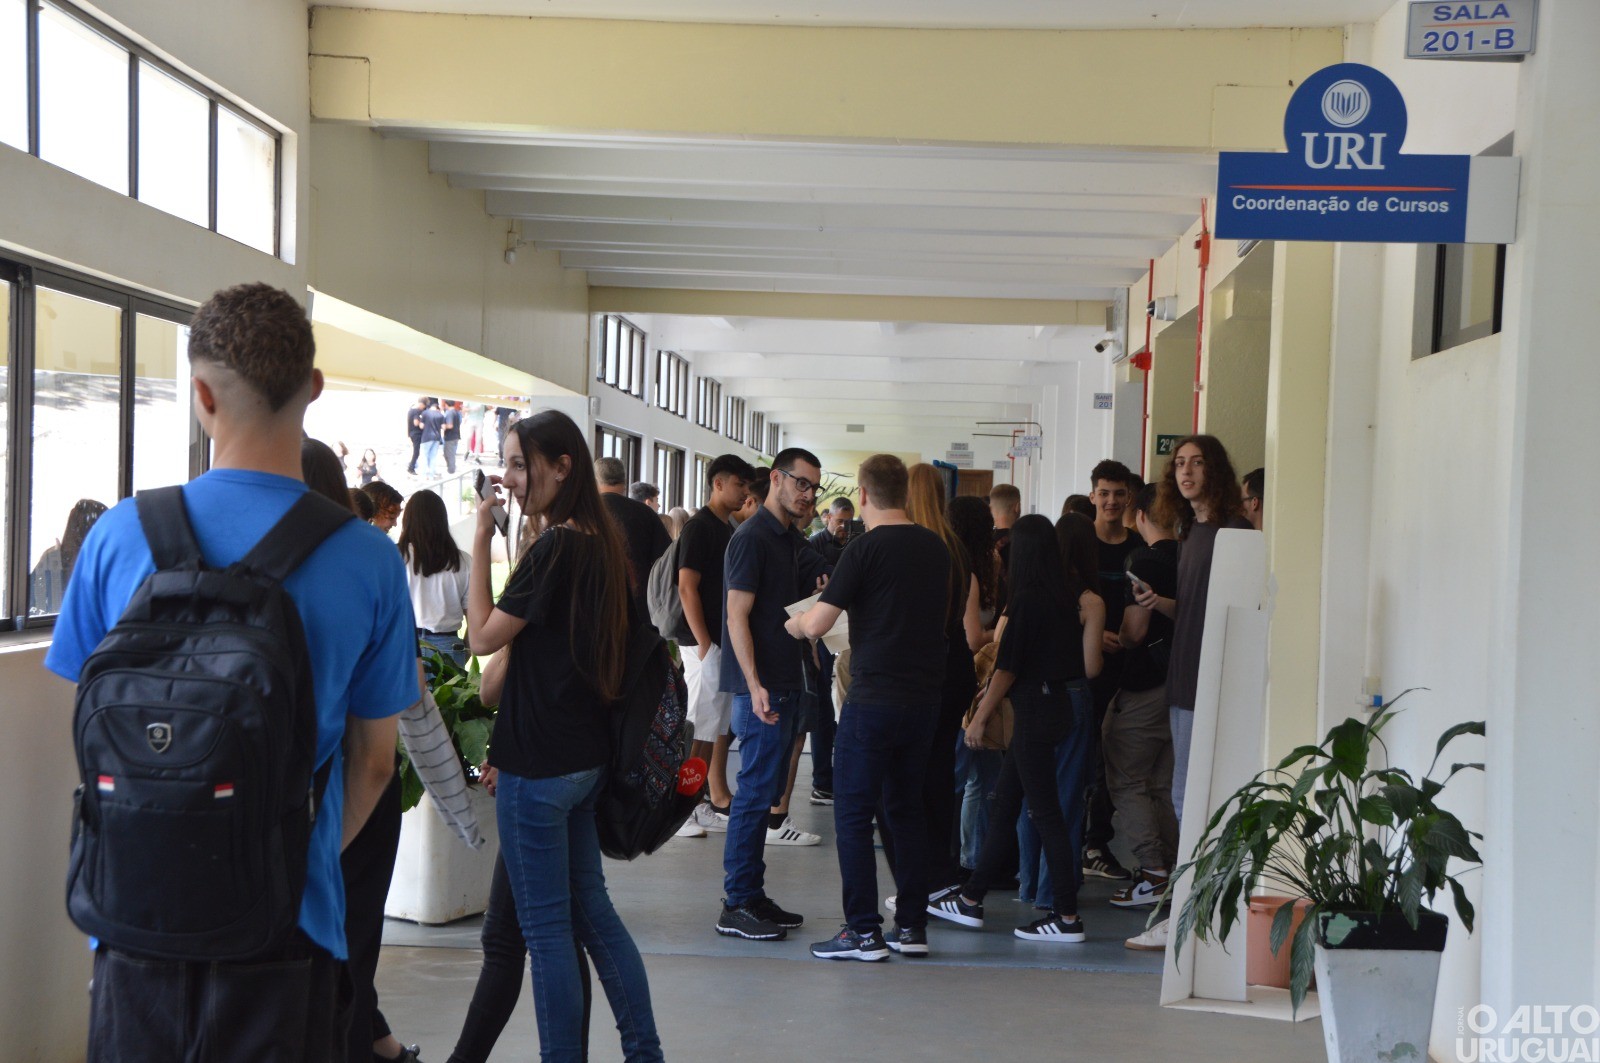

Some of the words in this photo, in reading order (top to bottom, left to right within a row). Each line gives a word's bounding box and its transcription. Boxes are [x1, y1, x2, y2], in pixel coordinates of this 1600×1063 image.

[1433, 3, 1510, 21] SALA
[1422, 28, 1515, 52] 201-B
[1301, 132, 1387, 170] URI
[1232, 195, 1350, 215] Coordenação
[1356, 197, 1379, 212] de
[1385, 197, 1450, 213] Cursos
[682, 767, 695, 776] Te
